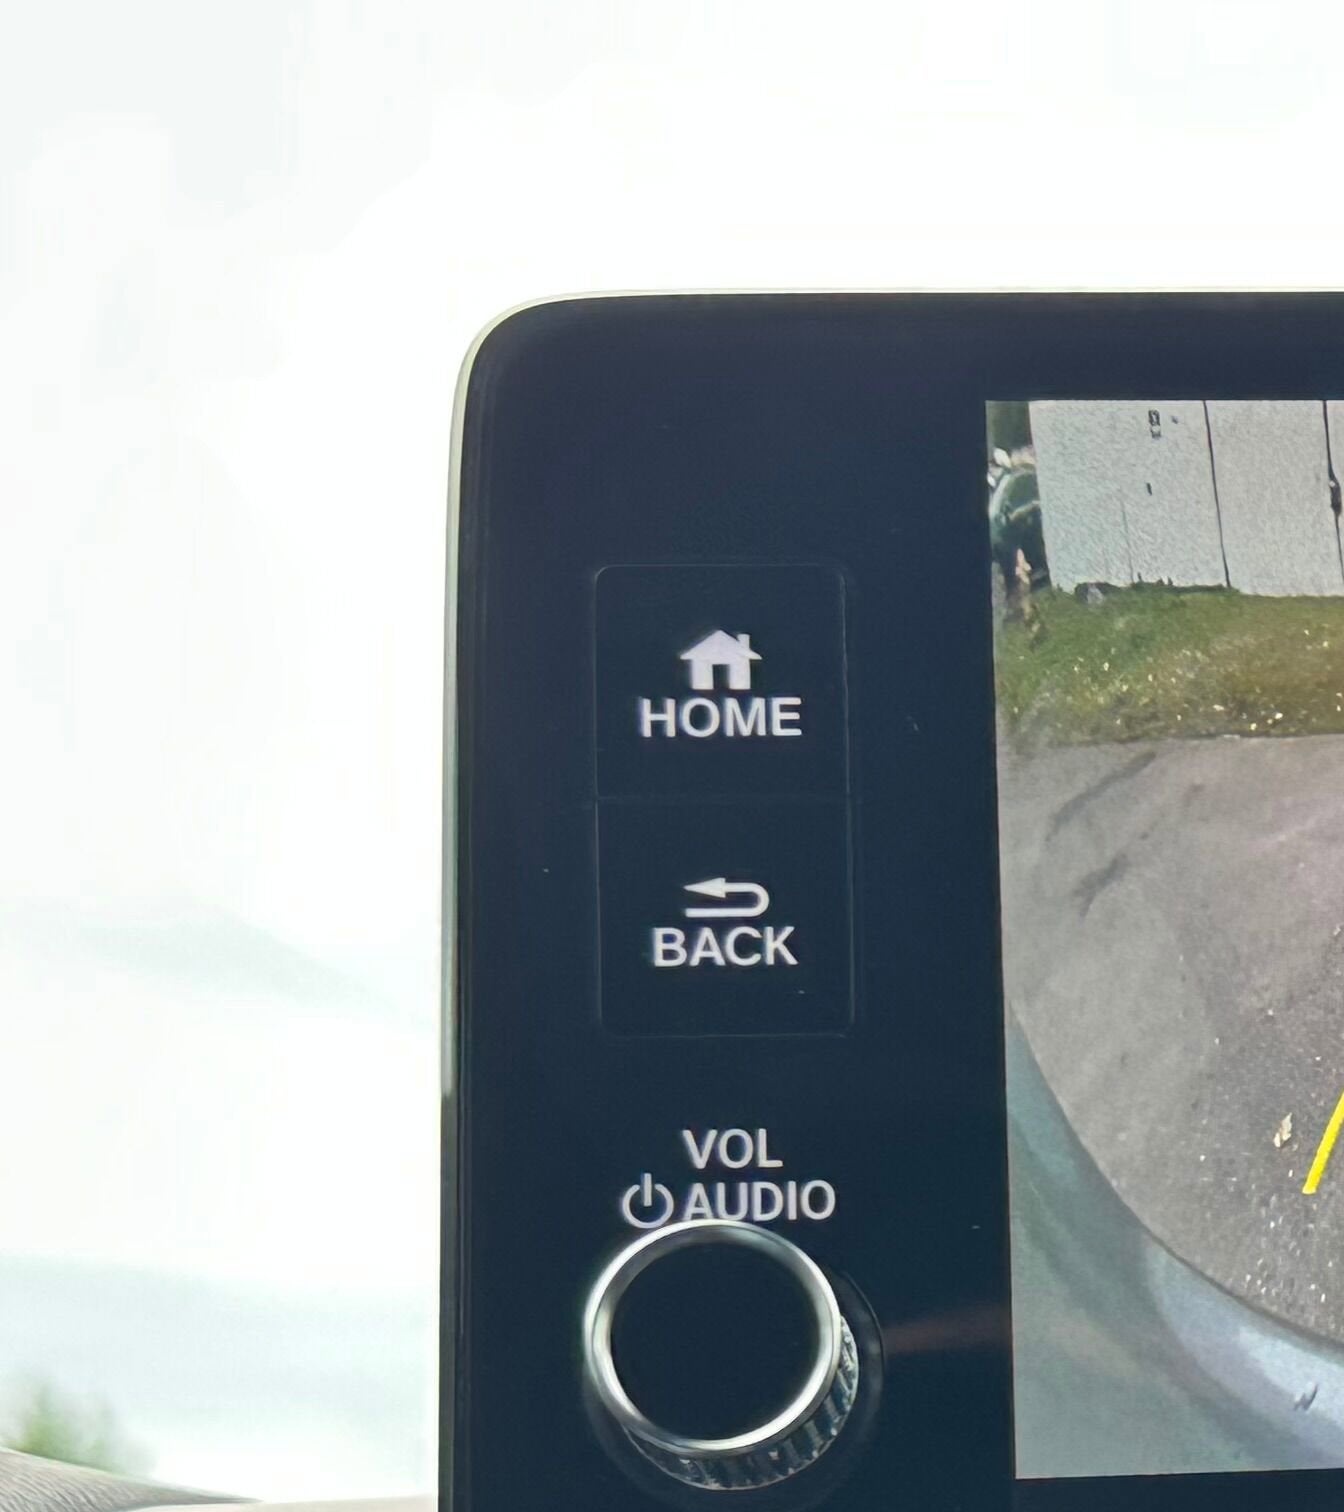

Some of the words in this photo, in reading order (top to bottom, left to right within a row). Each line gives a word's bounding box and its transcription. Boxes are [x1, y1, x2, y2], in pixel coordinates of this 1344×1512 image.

[638, 696, 803, 738] HOME
[651, 925, 799, 967] BACK
[682, 1128, 784, 1169] VOL
[682, 1179, 837, 1222] AUDIO
